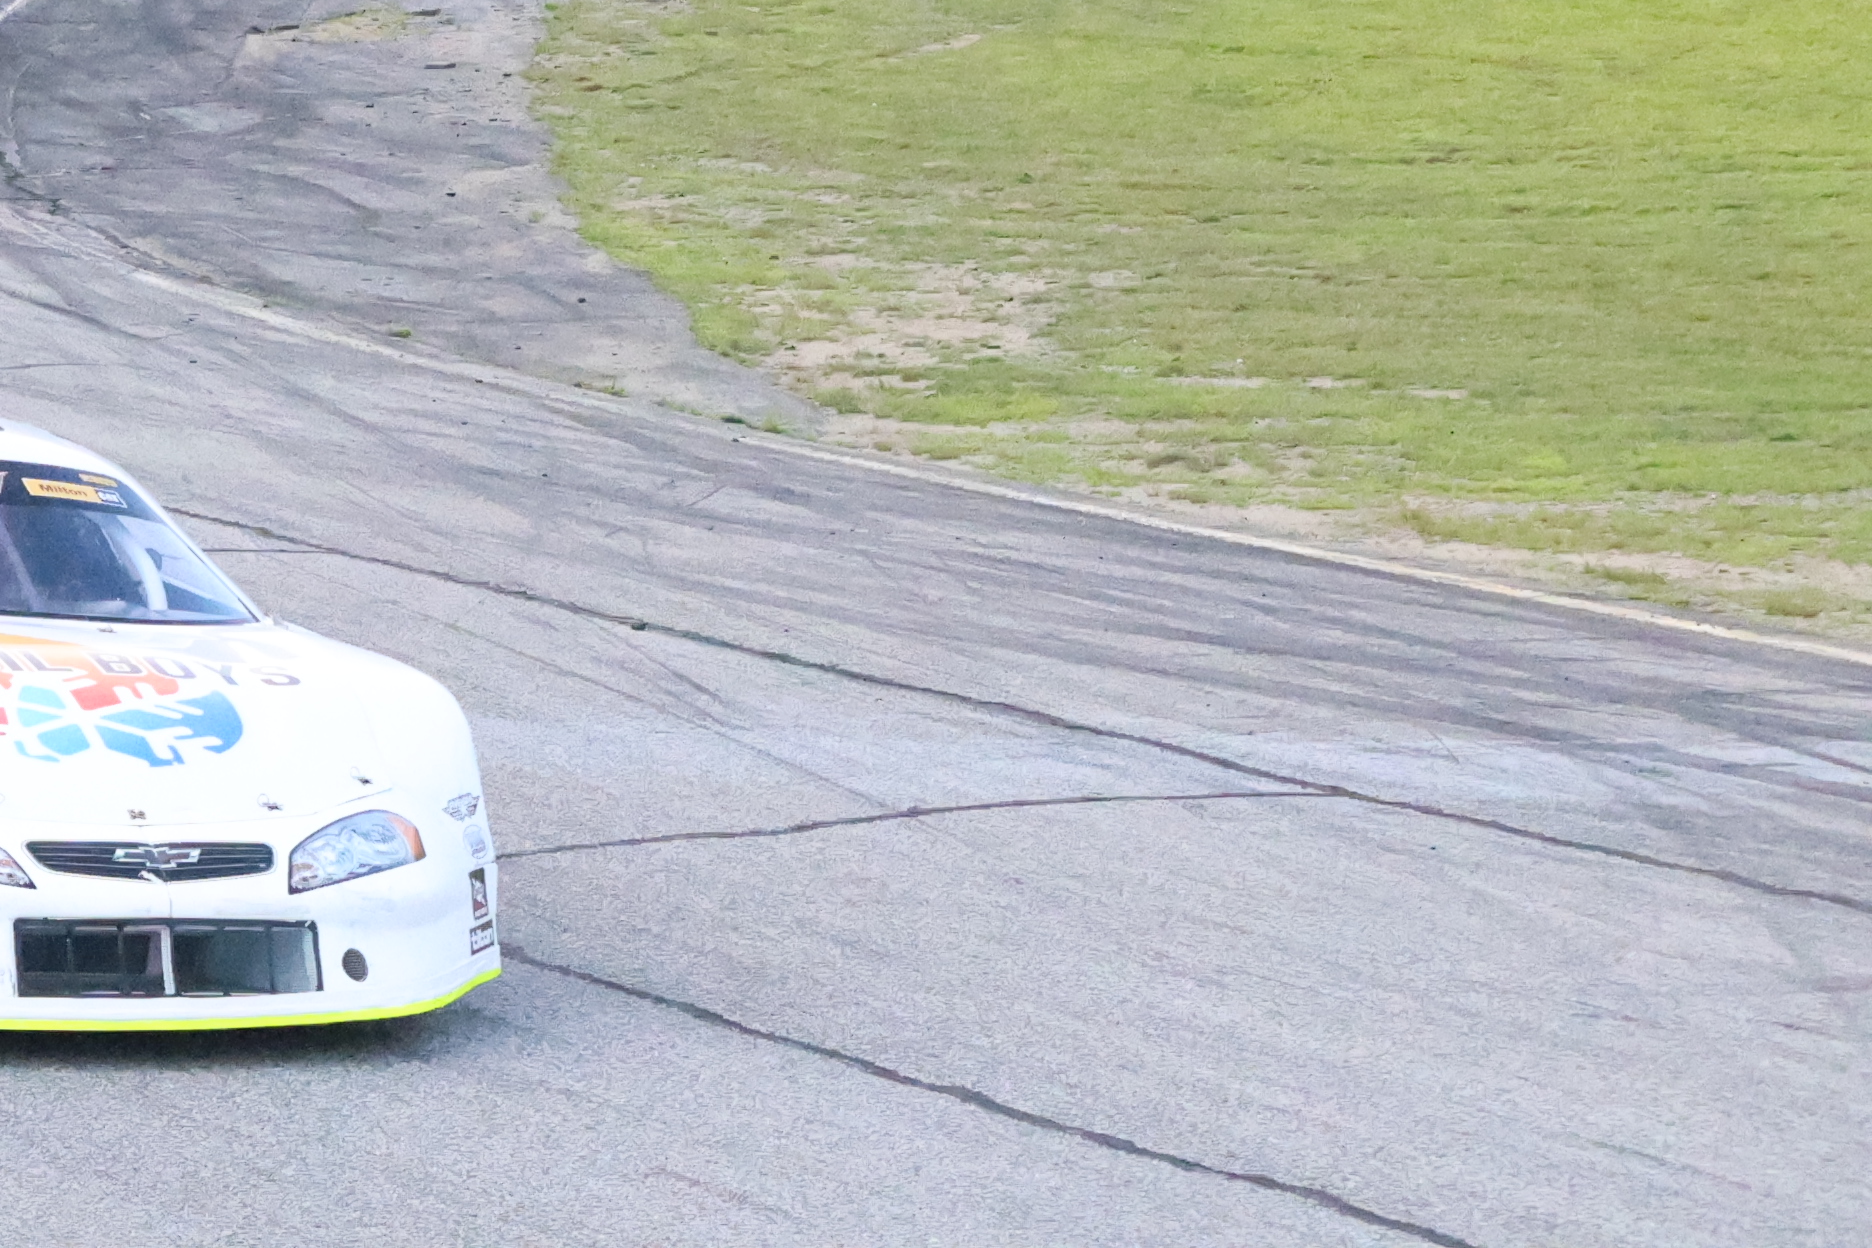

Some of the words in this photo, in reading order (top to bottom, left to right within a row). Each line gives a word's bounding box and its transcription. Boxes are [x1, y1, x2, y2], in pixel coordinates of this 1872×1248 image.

[38, 482, 89, 499] Milton
[98, 491, 121, 507] CAT
[89, 650, 302, 688] BOYS
